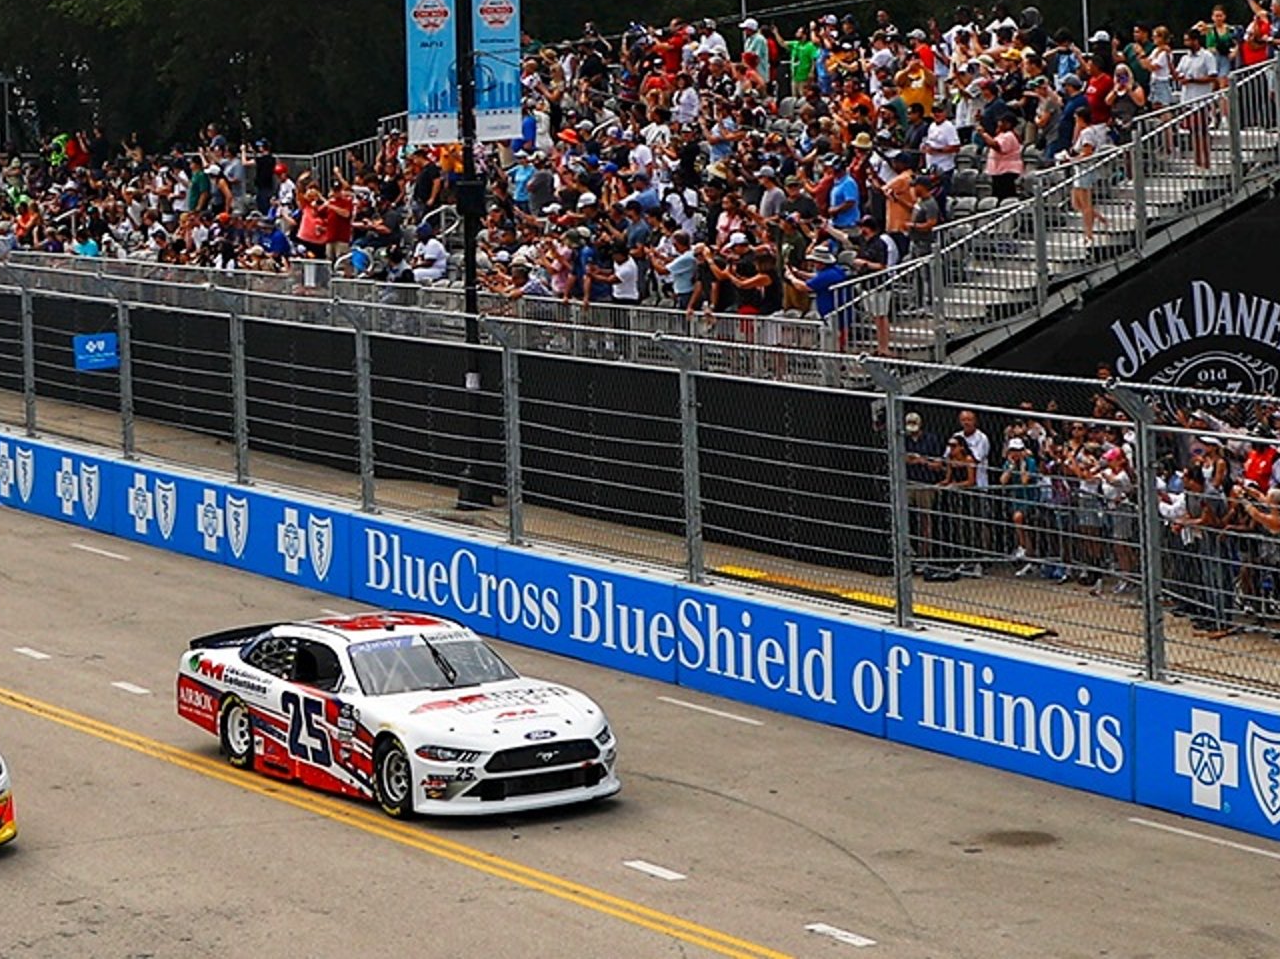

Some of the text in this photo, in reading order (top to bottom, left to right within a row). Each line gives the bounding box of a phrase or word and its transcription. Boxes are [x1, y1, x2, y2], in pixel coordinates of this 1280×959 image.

[1111, 298, 1193, 377] JACK
[365, 528, 1124, 774] BlueCross BlueShield of Illinois
[281, 691, 333, 767] 25
[456, 767, 476, 781] 25
